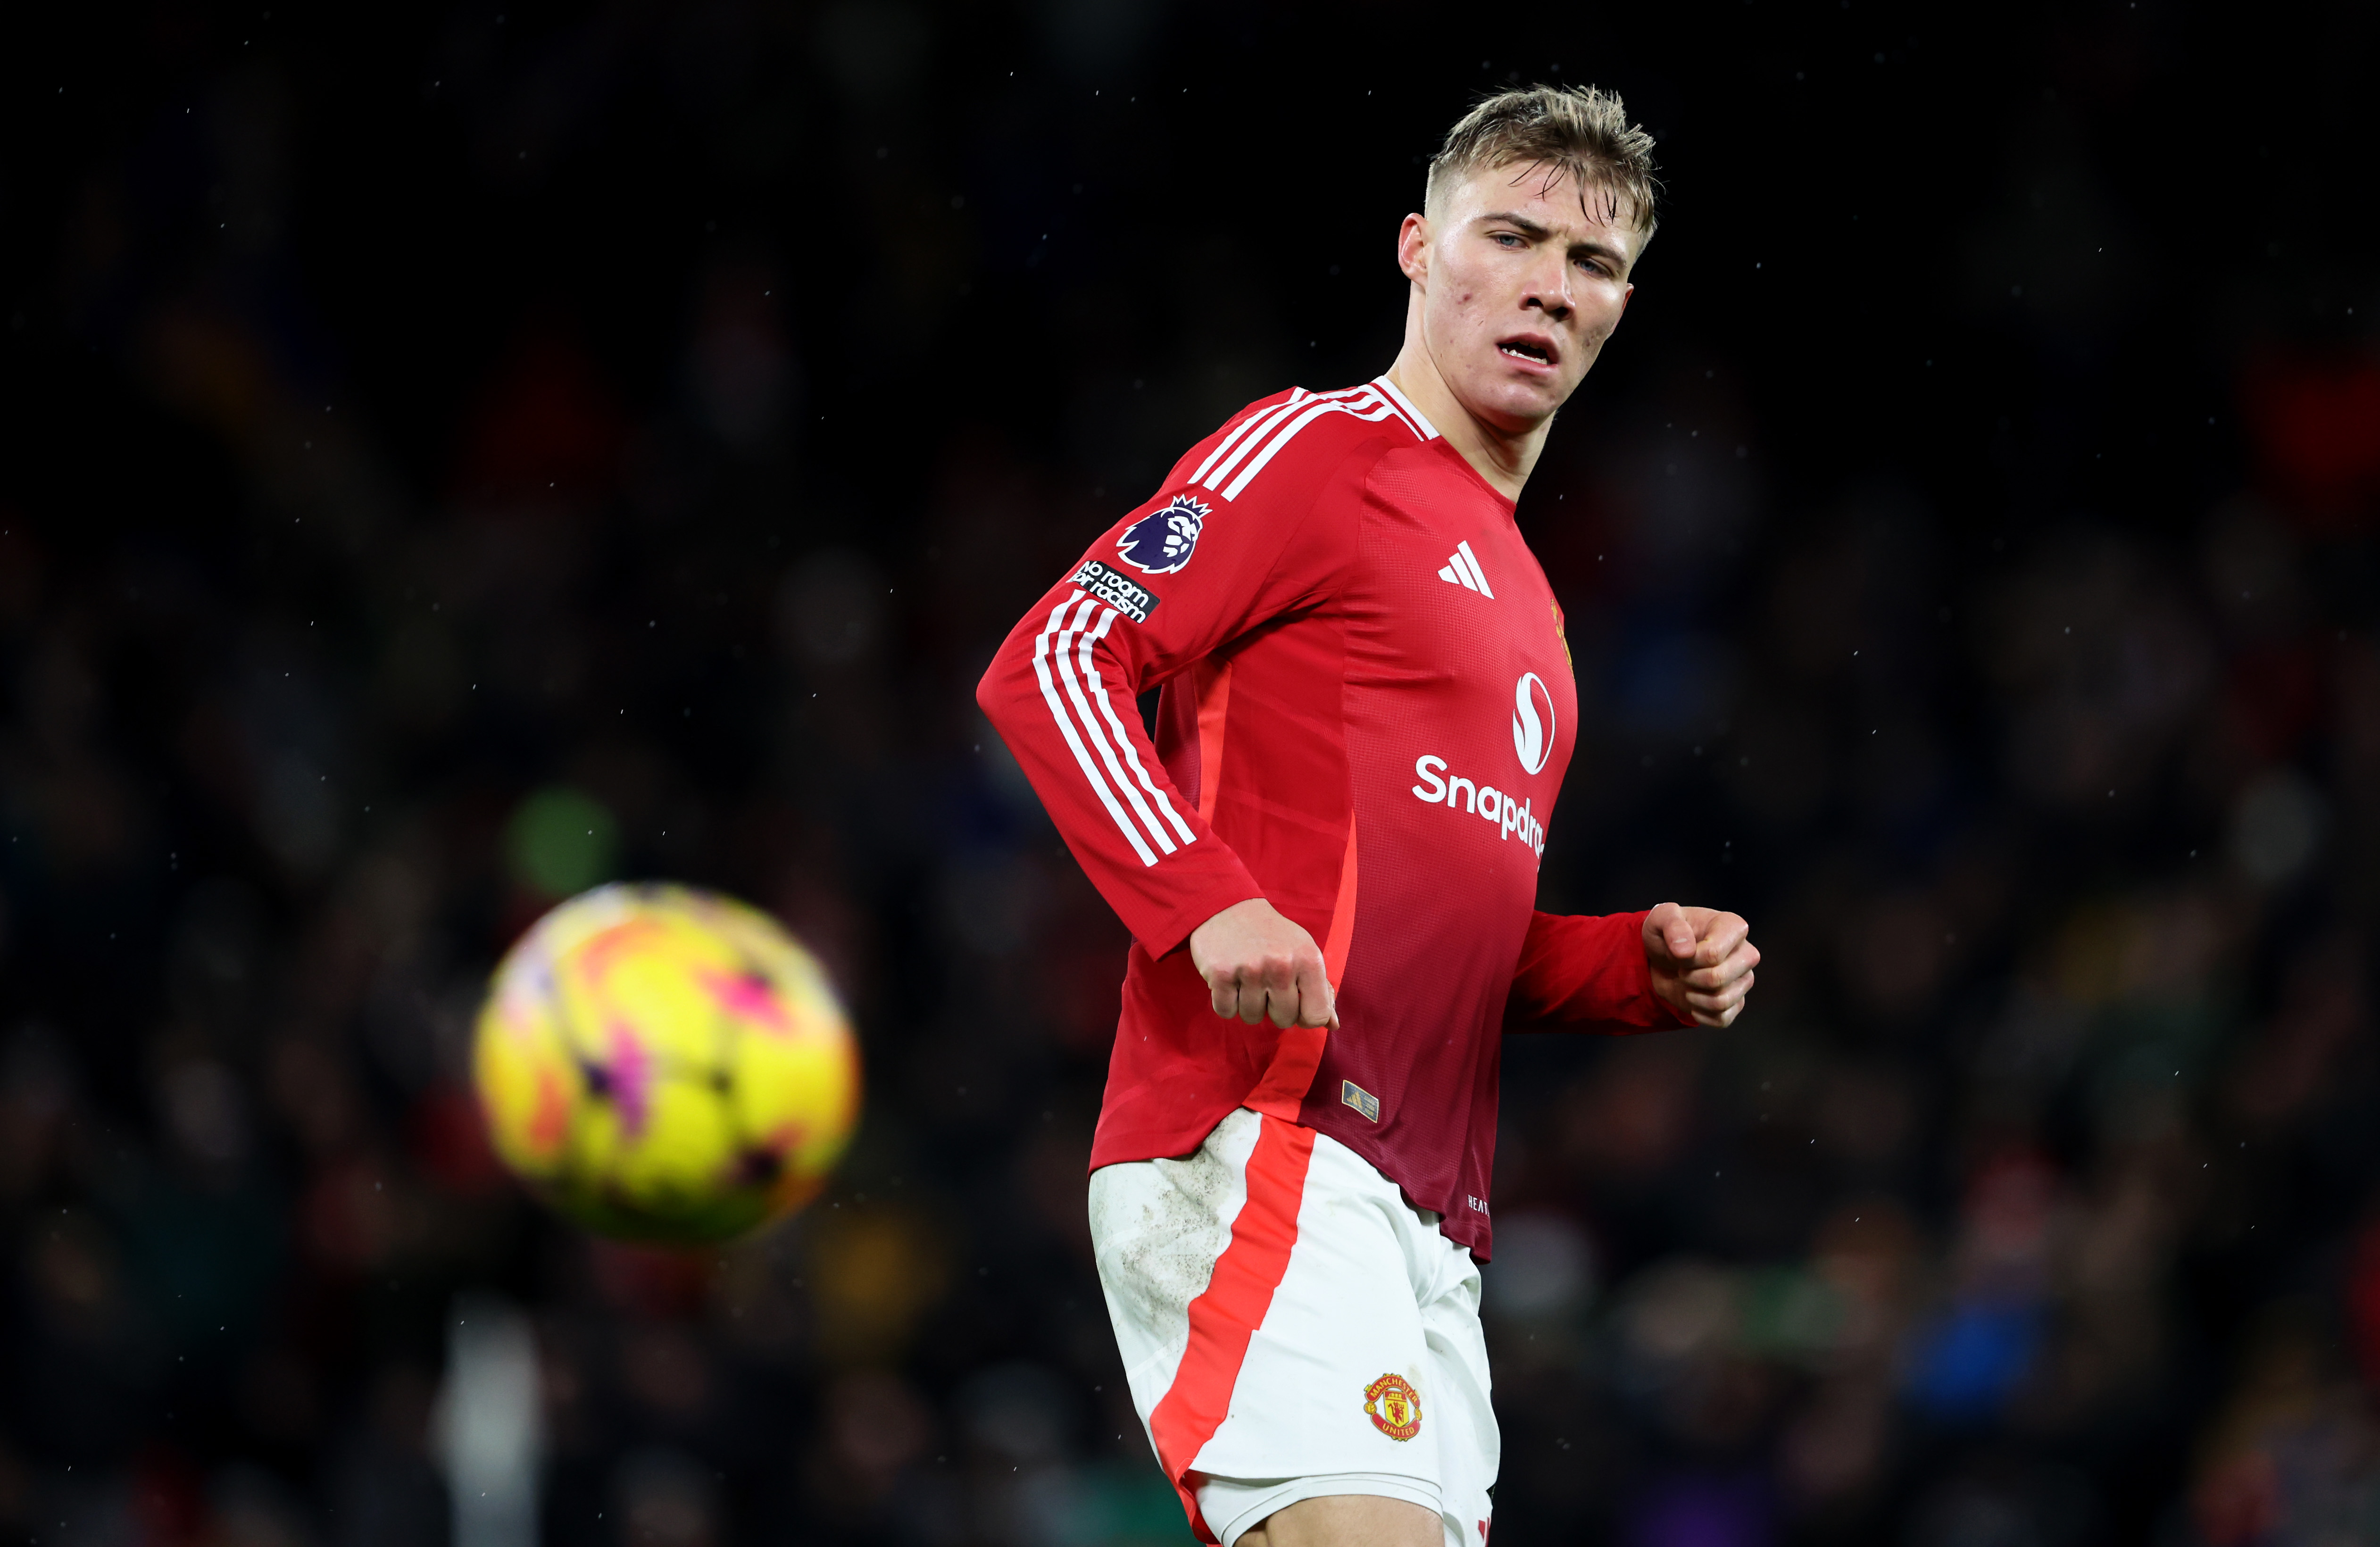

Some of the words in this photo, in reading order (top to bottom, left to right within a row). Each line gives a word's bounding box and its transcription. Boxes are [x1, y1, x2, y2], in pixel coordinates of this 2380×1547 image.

[1077, 561, 1103, 576] No
[1100, 571, 1148, 608] room
[1065, 572, 1094, 586] for
[1090, 582, 1146, 624] racism
[1468, 1194, 1490, 1218] HEAT
[1370, 1378, 1418, 1403] MANCHESTER
[1382, 1423, 1414, 1436] UNITED
